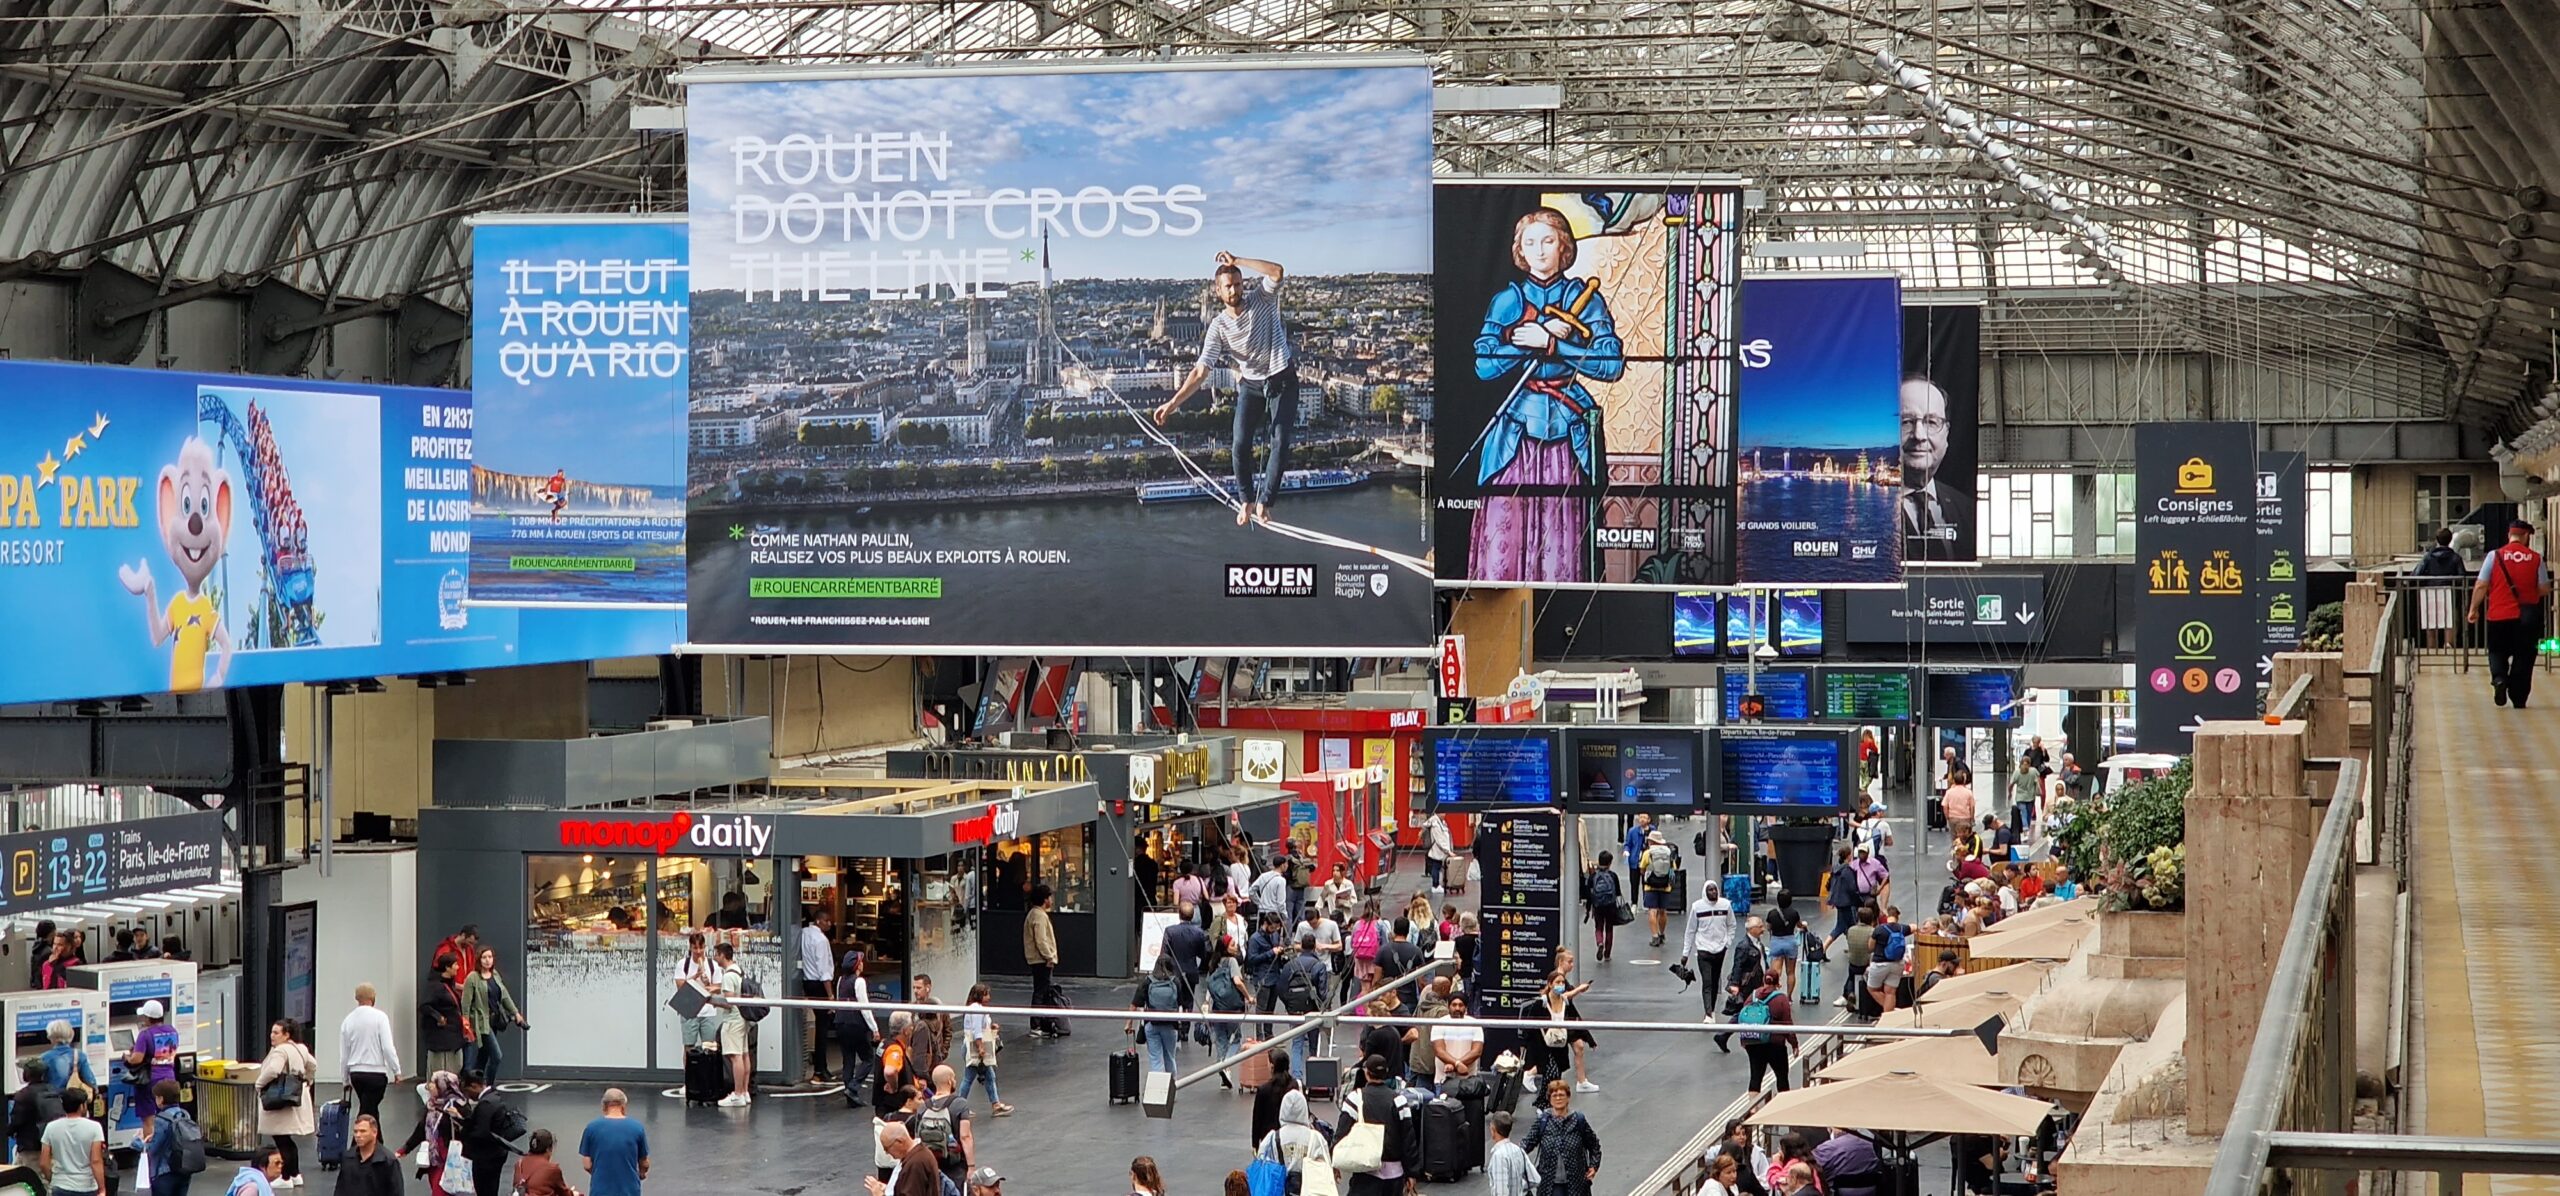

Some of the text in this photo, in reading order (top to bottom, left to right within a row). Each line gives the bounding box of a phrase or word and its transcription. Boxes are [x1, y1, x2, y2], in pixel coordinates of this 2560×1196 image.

[735, 130, 948, 186] ROUEN
[735, 183, 1205, 245] DO NOT CROSS
[505, 259, 678, 295] IL PLEUT
[730, 247, 1009, 303] THE LINE
[500, 296, 679, 336] À ROUEN
[609, 341, 681, 378] RIO
[423, 405, 473, 429] EN 2H37
[411, 436, 472, 460] PROFITEZ
[404, 467, 468, 490] MEILLEUR
[59, 476, 140, 528] PARK
[407, 499, 425, 521] DE
[1437, 497, 1484, 510] À ROUEN.
[2158, 497, 2234, 514] Consignes
[569, 515, 641, 527] PRÉCIPITATIONS
[642, 514, 650, 527] À
[652, 517, 668, 527] RIO
[671, 518, 683, 527] DE
[1747, 522, 1780, 530] GRANDS
[1781, 521, 1819, 531] VOILIERS.
[2144, 514, 2248, 525] Left luggage Schließfächer
[430, 531, 470, 553] MOND
[511, 527, 680, 541] 776 MM À ROUEN (SPOTS DE KITESURF
[750, 534, 914, 548] COMME NATHAN PAULIN,
[1597, 528, 1655, 543] ROUEN
[1, 539, 65, 566] RESORT
[1793, 541, 1839, 552] ROUEN
[1852, 545, 1877, 555] CHU
[2161, 550, 2178, 559] WC
[2213, 550, 2230, 559] WC
[512, 556, 633, 569] #ROUENCARRÉMENTBARRÉ
[750, 546, 1071, 564] RÉALISEZ VOS PLUS BEAUX EXPLOITS À ROUEN.
[1338, 563, 1352, 571] Avec
[1382, 563, 1389, 571] de
[1229, 567, 1313, 587] ROUEN
[1335, 572, 1365, 582] Rouen
[753, 577, 939, 594] #ROUENCARRÉMENTBARRÉ
[1229, 586, 1312, 595] NORMANDY INVEST
[1335, 587, 1365, 599] Rugby
[1929, 597, 1965, 609] Sortie
[791, 616, 802, 625] NE
[805, 616, 867, 625] FRANCHISSEZ
[869, 616, 886, 625] PAS
[888, 616, 900, 625] LA
[902, 616, 930, 625] LIGNE
[1891, 609, 1904, 618] Rue
[1926, 609, 1965, 618] Saint-Martin
[2267, 625, 2295, 634] Location
[2185, 629, 2205, 648] M
[1445, 643, 1457, 698] TABAC
[2156, 672, 2169, 687] 4
[2191, 672, 2201, 688] 5
[2223, 672, 2234, 688] 7
[1720, 729, 1742, 737] Départs
[1743, 729, 1758, 738] Paris,
[994, 802, 1020, 840] daily
[120, 829, 142, 845] Trains
[690, 815, 772, 856] daily
[120, 840, 210, 870] Paris, Île-de-France
[20, 861, 29, 885] P
[48, 848, 107, 891] 13 à 22
[119, 874, 145, 888] Suburban
[146, 871, 166, 885] services
